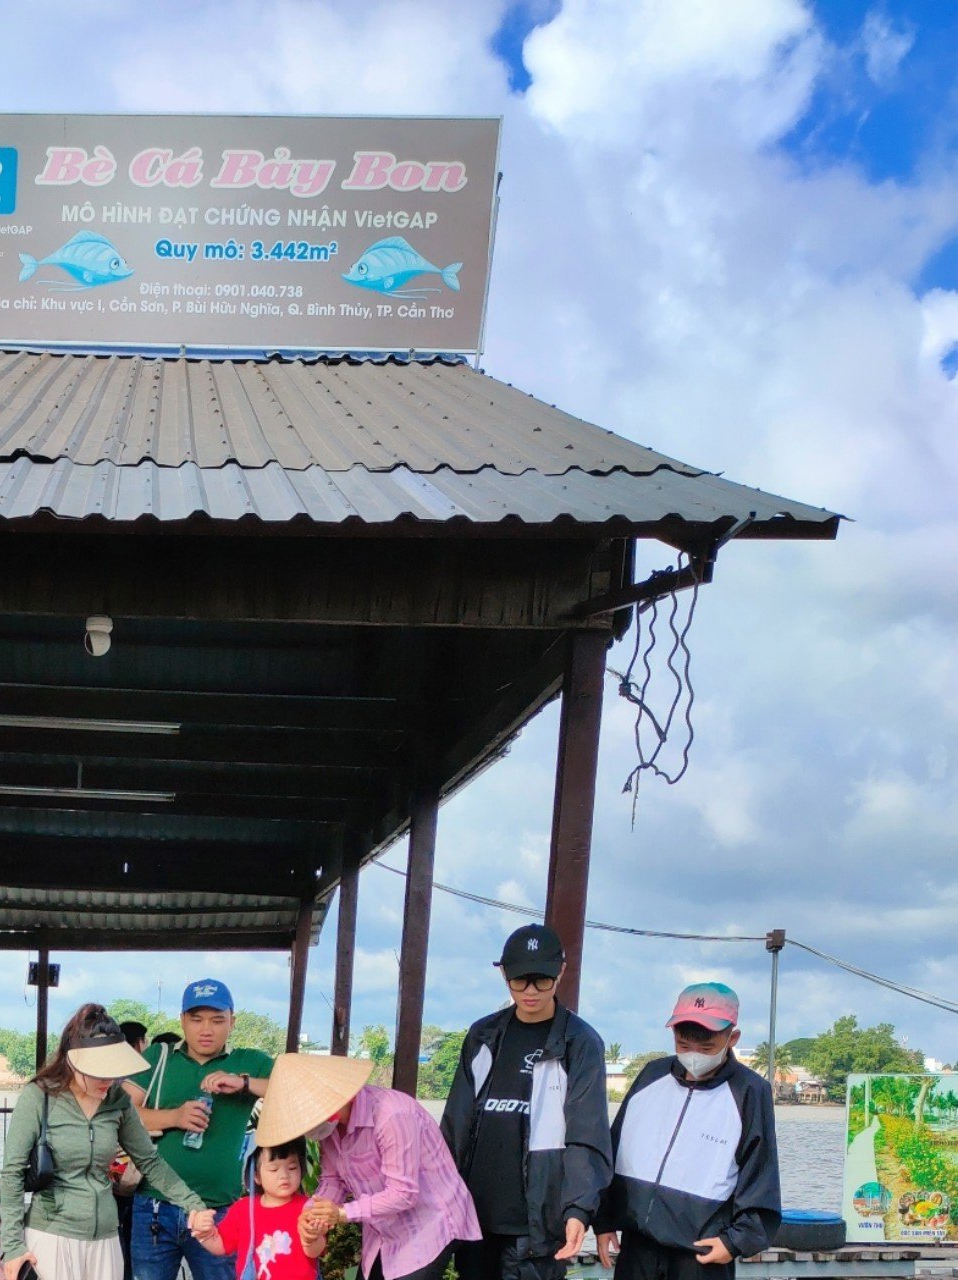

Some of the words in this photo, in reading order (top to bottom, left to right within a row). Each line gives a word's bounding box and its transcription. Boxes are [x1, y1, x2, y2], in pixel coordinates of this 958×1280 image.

[35, 146, 117, 187] Bè
[128, 146, 204, 188] Cá
[211, 146, 336, 198] Bảy
[341, 151, 468, 192] Bon
[61, 201, 96, 223] MÔ
[102, 202, 151, 224] HÌNH
[158, 206, 198, 229] ĐẠT
[204, 202, 280, 227] CHỨNG
[286, 204, 347, 231] NHẬN
[353, 208, 438, 230] VietGAP
[155, 239, 199, 261] Quy
[204, 239, 244, 260] mô:
[139, 282, 170, 296] Điện
[173, 282, 211, 298] thoại:
[13, 295, 37, 311] chỉ:
[41, 299, 66, 311] Khu
[70, 299, 94, 313] vực
[109, 295, 137, 312] Cồn
[140, 300, 169, 315] Sơn,
[172, 301, 182, 313] P.
[186, 300, 207, 314] Bùi
[210, 301, 236, 315] Hữu
[287, 303, 304, 317] Q.
[307, 301, 336, 316] Bình
[376, 304, 394, 318] TP.
[397, 301, 426, 319] Cần
[429, 305, 455, 319] Thơ
